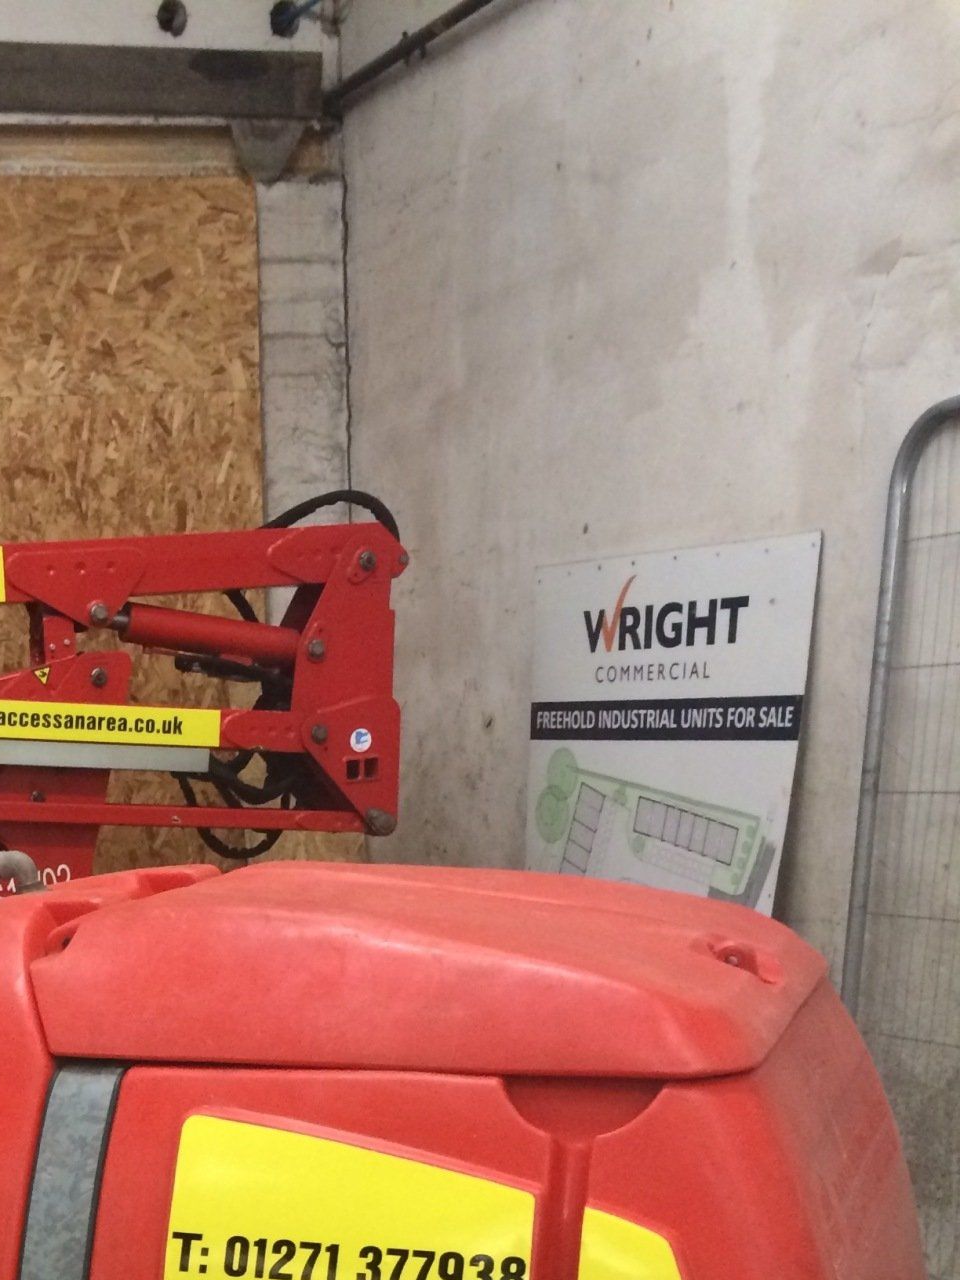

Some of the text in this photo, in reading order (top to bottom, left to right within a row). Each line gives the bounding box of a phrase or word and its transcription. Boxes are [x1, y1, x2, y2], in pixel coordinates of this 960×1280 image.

[583, 574, 750, 653] WRIGHT
[595, 661, 710, 684] COMMERCIAL
[536, 705, 795, 730] FREEHOLD INDUSTRIAL UNITS FOR SALE
[172, 1231, 210, 1274] T:
